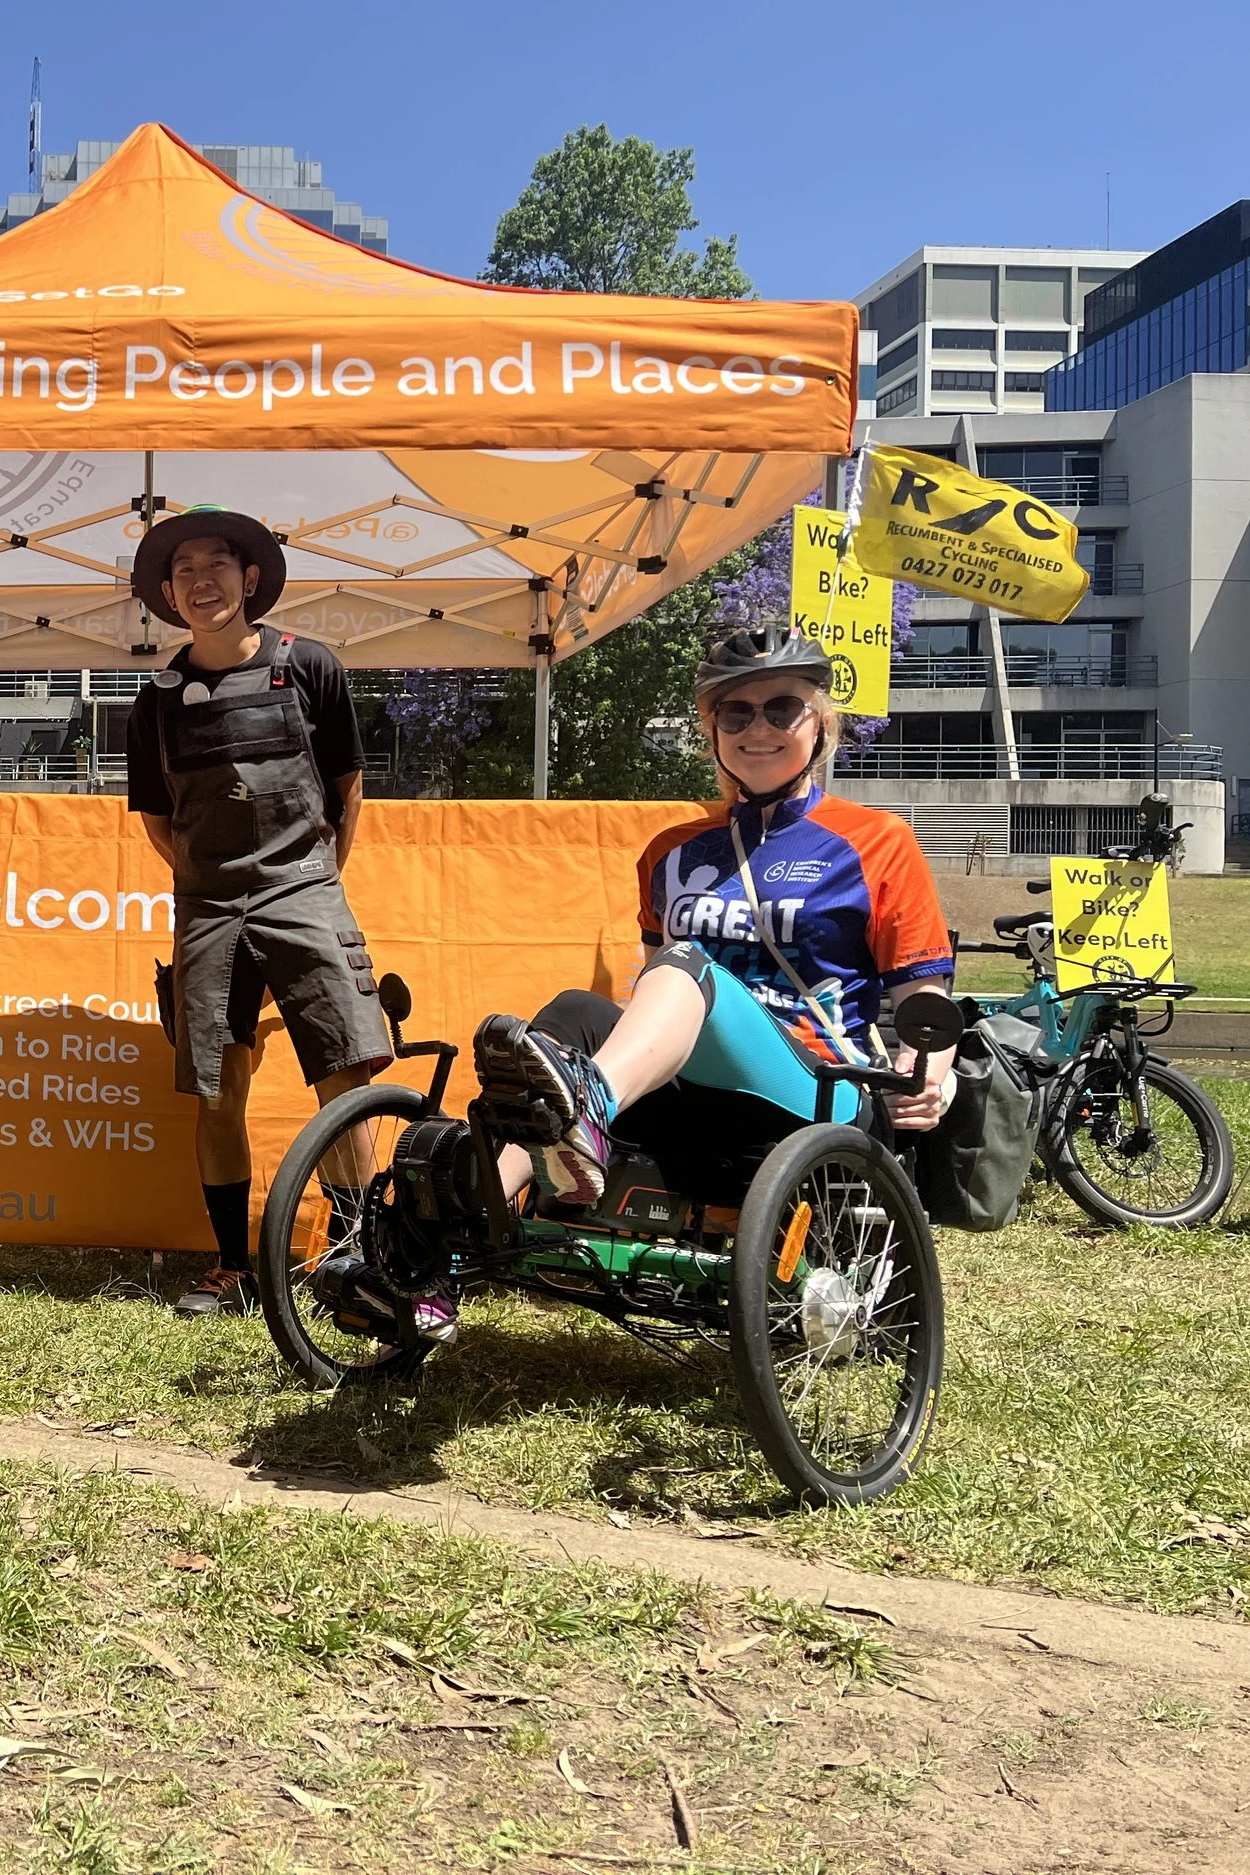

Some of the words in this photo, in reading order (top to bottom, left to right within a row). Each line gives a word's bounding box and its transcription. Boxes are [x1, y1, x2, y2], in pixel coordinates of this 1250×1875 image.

[124, 344, 375, 410] People
[397, 342, 535, 395] and
[562, 342, 806, 397] Places
[886, 520, 964, 548] RECUMBENT
[967, 540, 978, 551] &
[981, 541, 1063, 574] SPECIALISED
[940, 545, 999, 572] CYCLING
[901, 556, 948, 578] 0427
[952, 568, 984, 589] 073
[988, 578, 1023, 601] 017
[794, 612, 845, 646] Keep
[851, 620, 889, 647] Left
[1065, 868, 1122, 887] Walk
[1130, 876, 1152, 887] or
[1082, 900, 1139, 917] Bike?
[1058, 929, 1117, 950] Keep
[1124, 932, 1168, 950] Left
[15, 1031, 48, 1059] to
[61, 1033, 140, 1064] Ride
[42, 1073, 141, 1106] Rides
[28, 1118, 53, 1148] &
[63, 1119, 155, 1152] WHS
